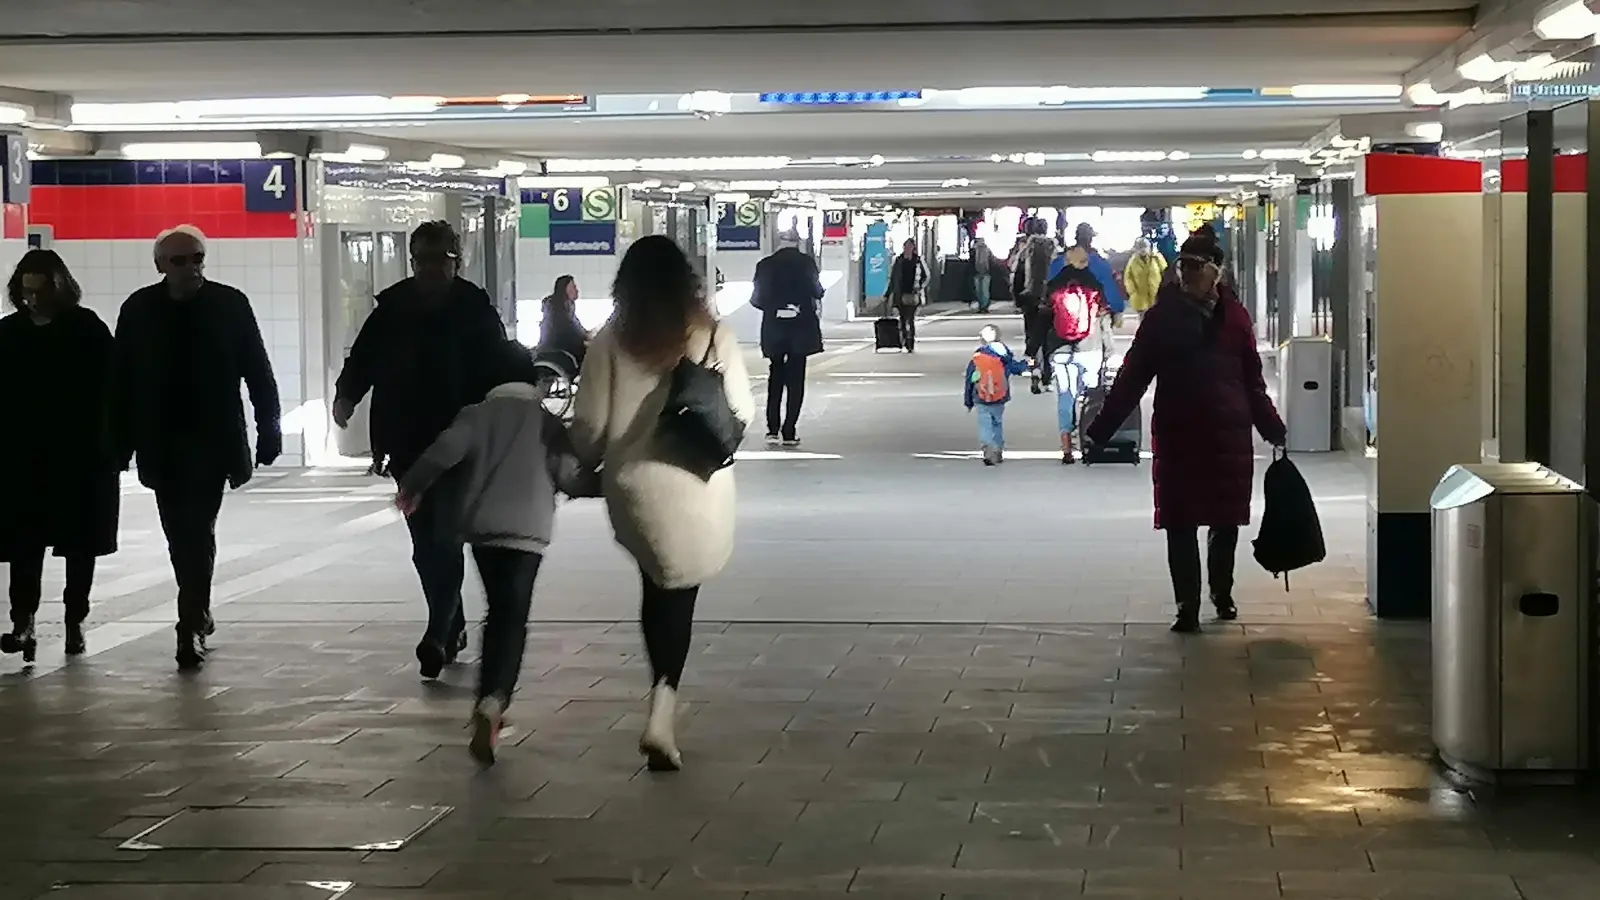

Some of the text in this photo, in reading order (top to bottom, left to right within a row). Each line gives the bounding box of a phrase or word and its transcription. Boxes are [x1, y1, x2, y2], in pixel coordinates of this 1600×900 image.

[12, 140, 23, 185] 3
[263, 165, 286, 199] 4
[553, 188, 570, 212] 6
[585, 189, 612, 219] S
[738, 201, 756, 223] S
[827, 210, 842, 225] 10
